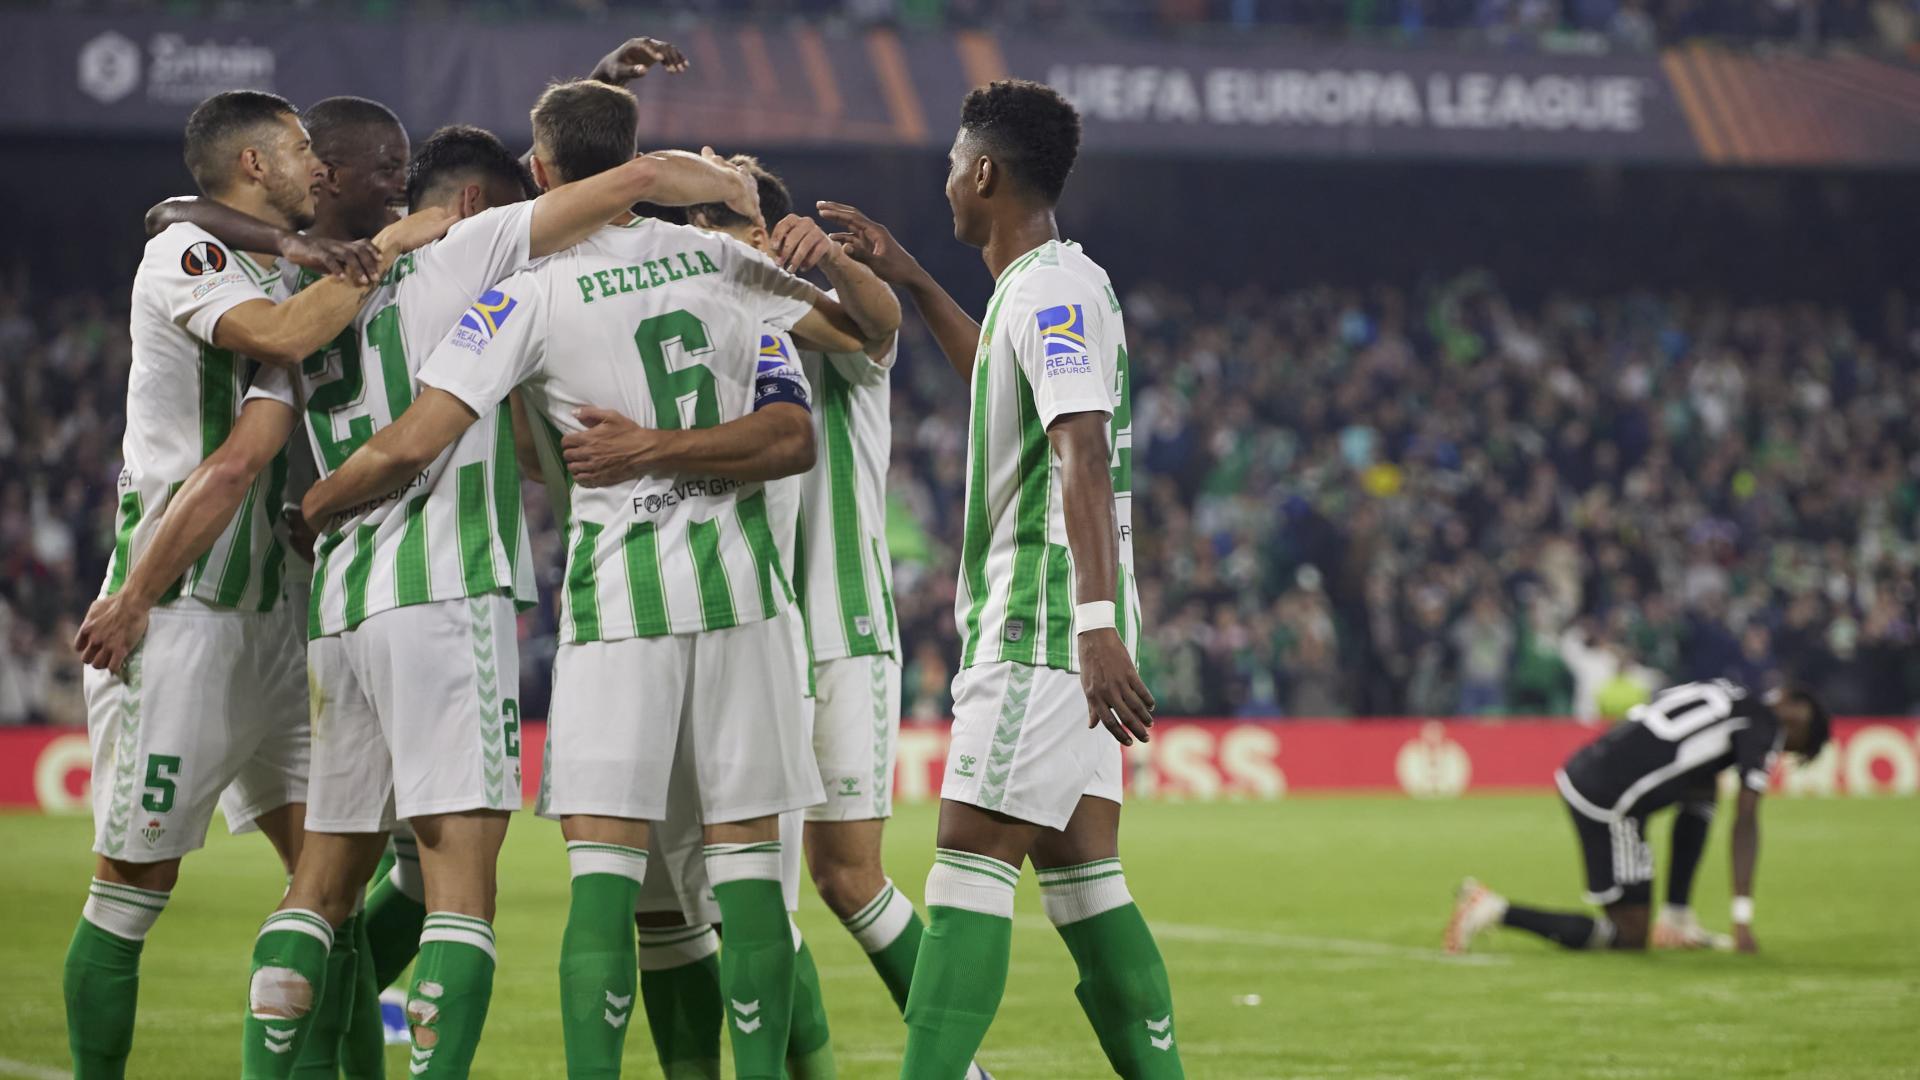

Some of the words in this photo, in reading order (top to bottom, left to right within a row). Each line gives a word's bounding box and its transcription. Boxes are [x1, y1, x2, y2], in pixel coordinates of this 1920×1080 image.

[1049, 64, 1198, 122] UEFA
[1207, 67, 1420, 127] EUROPA
[1426, 72, 1644, 132] LEAGUE
[577, 250, 718, 303] PEZZELLA
[456, 328, 488, 349] REALE
[1046, 355, 1090, 370] REALE
[634, 308, 724, 430] 6
[1047, 366, 1092, 378] SEGUROS
[141, 753, 182, 814] 5
